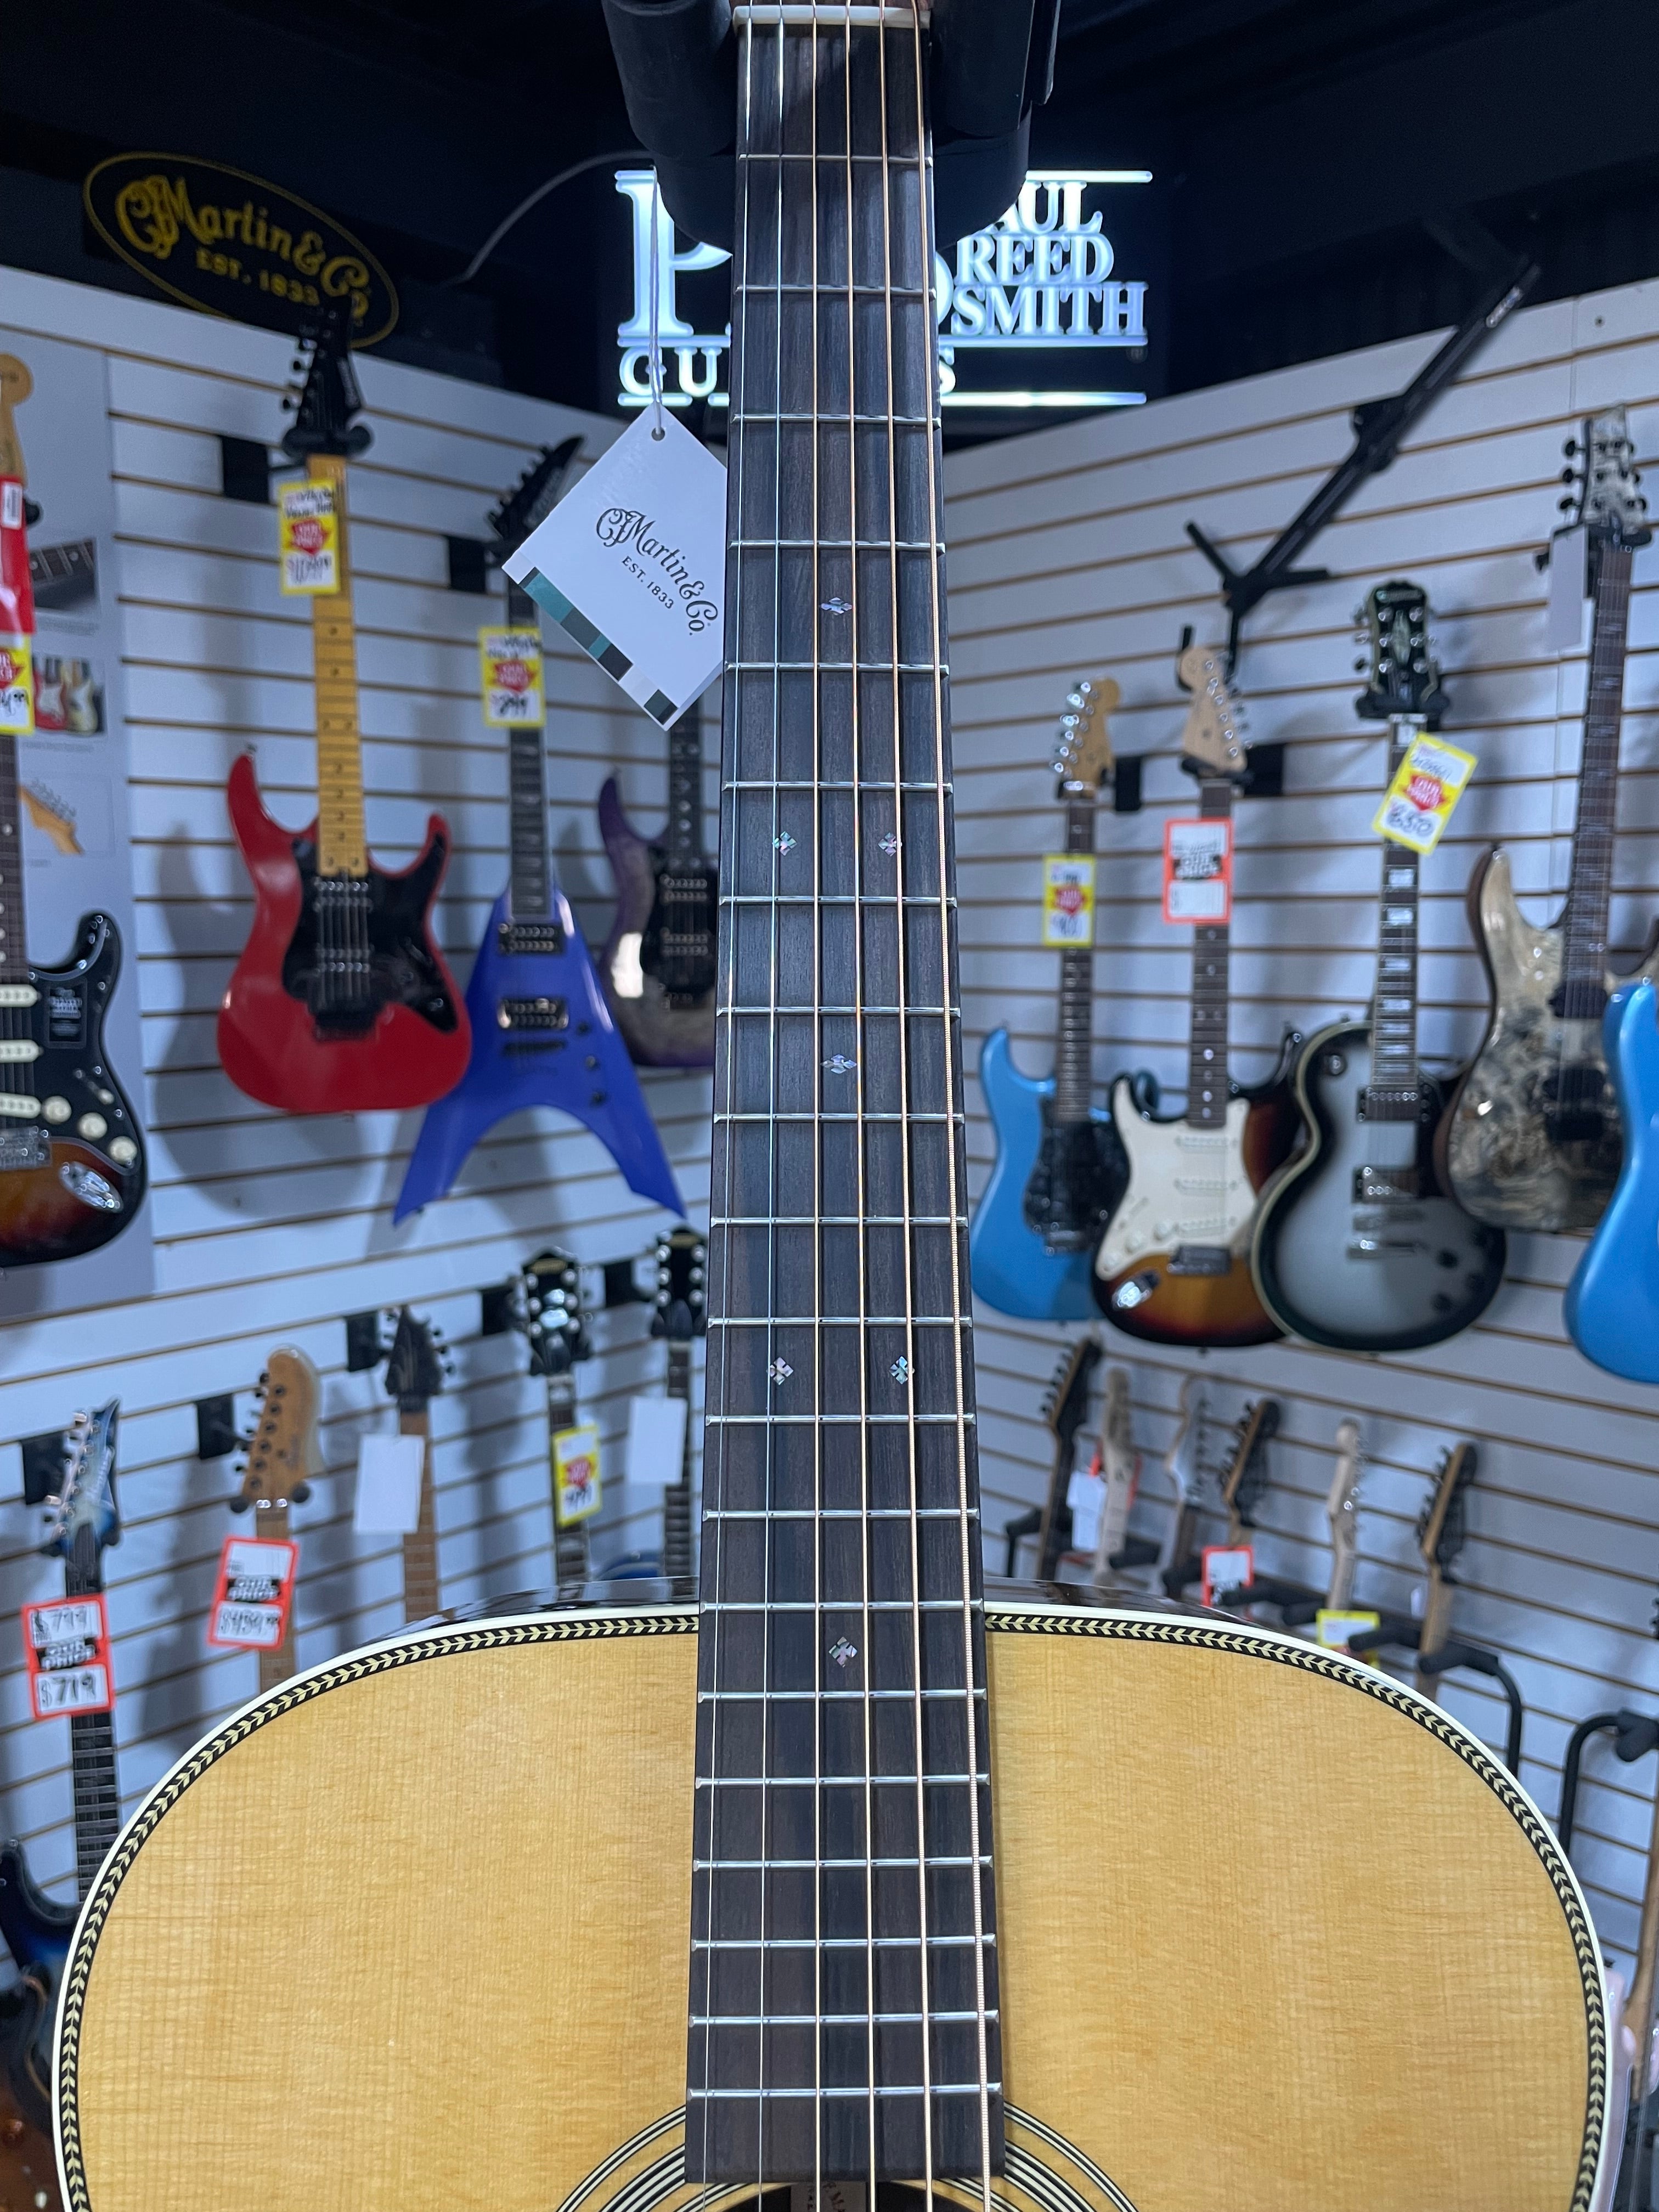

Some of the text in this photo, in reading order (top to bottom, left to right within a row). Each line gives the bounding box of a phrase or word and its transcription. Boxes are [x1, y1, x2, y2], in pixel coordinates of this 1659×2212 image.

[978, 181, 1103, 234] AUL
[955, 232, 1114, 285] REED
[951, 281, 1149, 336] SMITH
[622, 556, 674, 610] EST. 1833
